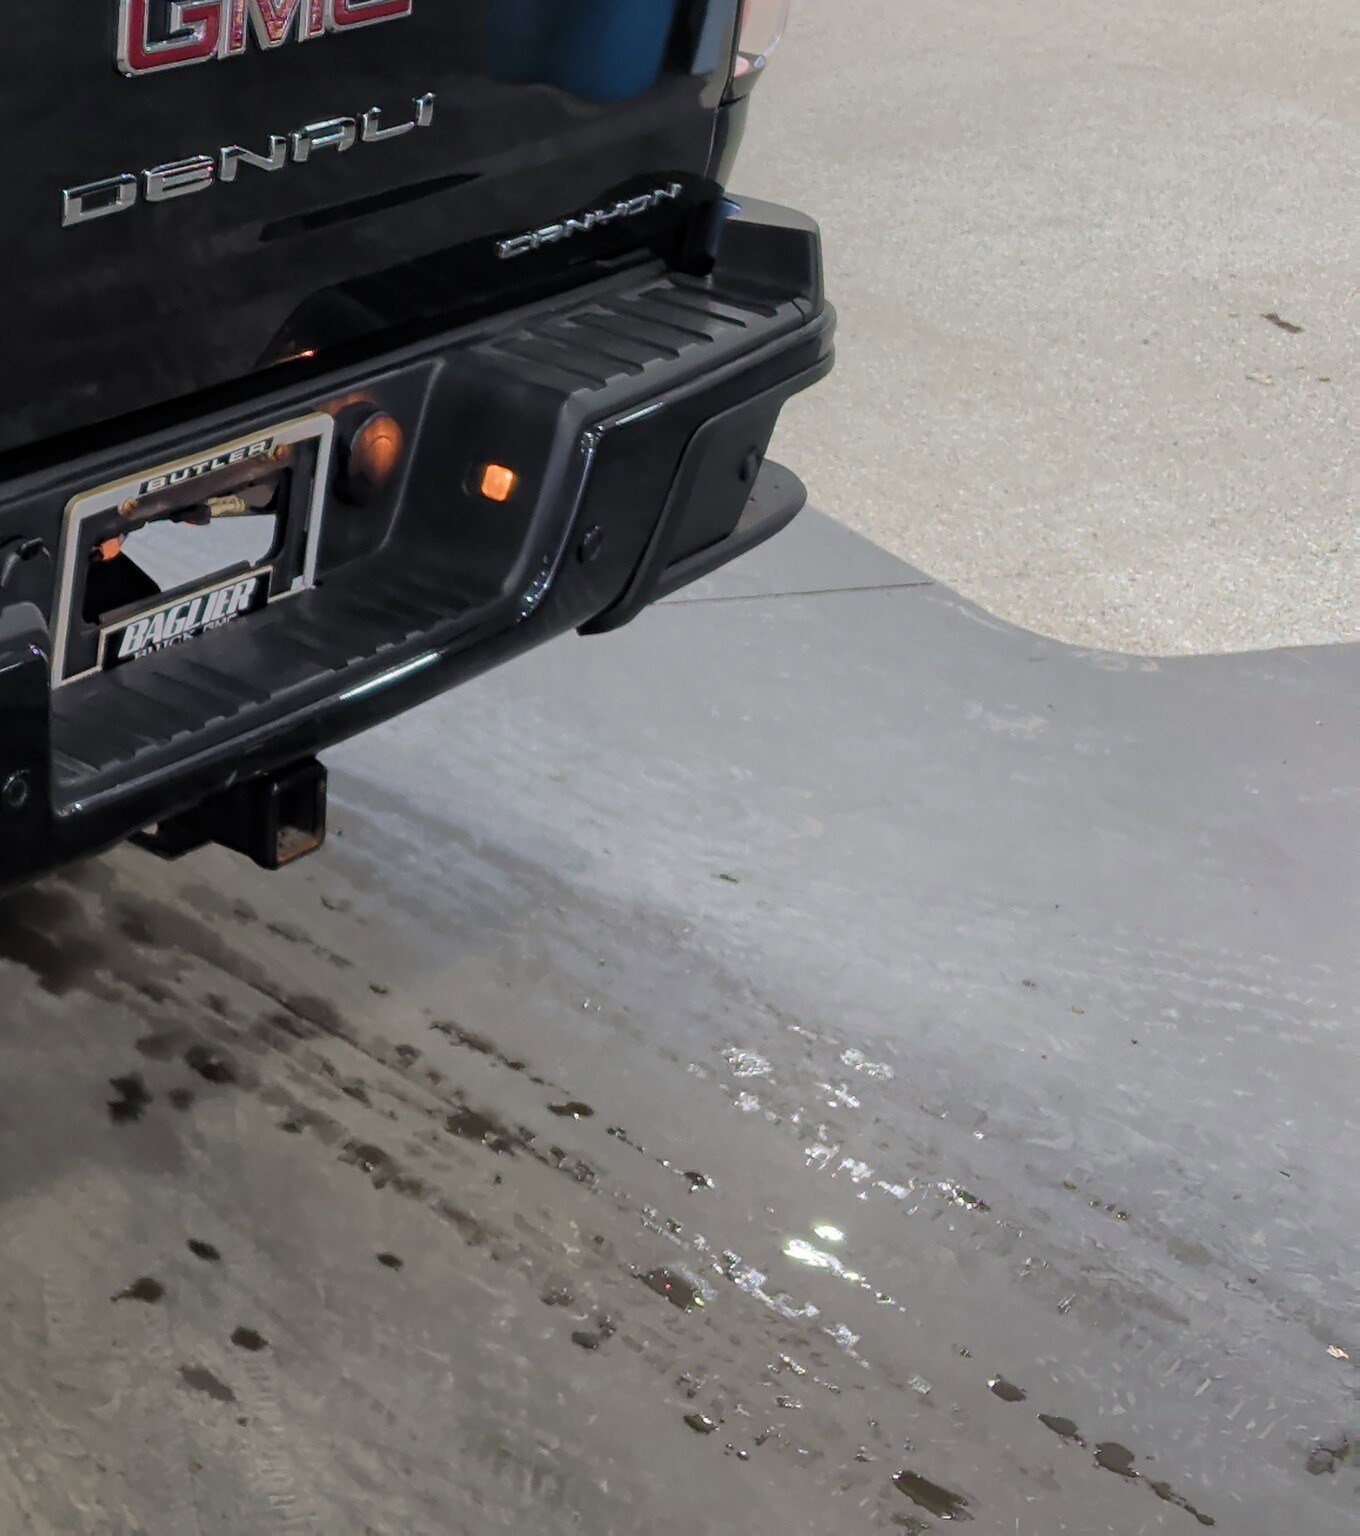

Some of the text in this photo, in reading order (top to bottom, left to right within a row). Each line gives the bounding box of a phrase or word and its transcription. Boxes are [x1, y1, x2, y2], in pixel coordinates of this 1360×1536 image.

[61, 92, 437, 227] DENALI
[495, 182, 683, 259] CANYON
[146, 440, 269, 492] BUTLER
[117, 577, 257, 659] BAGLIER
